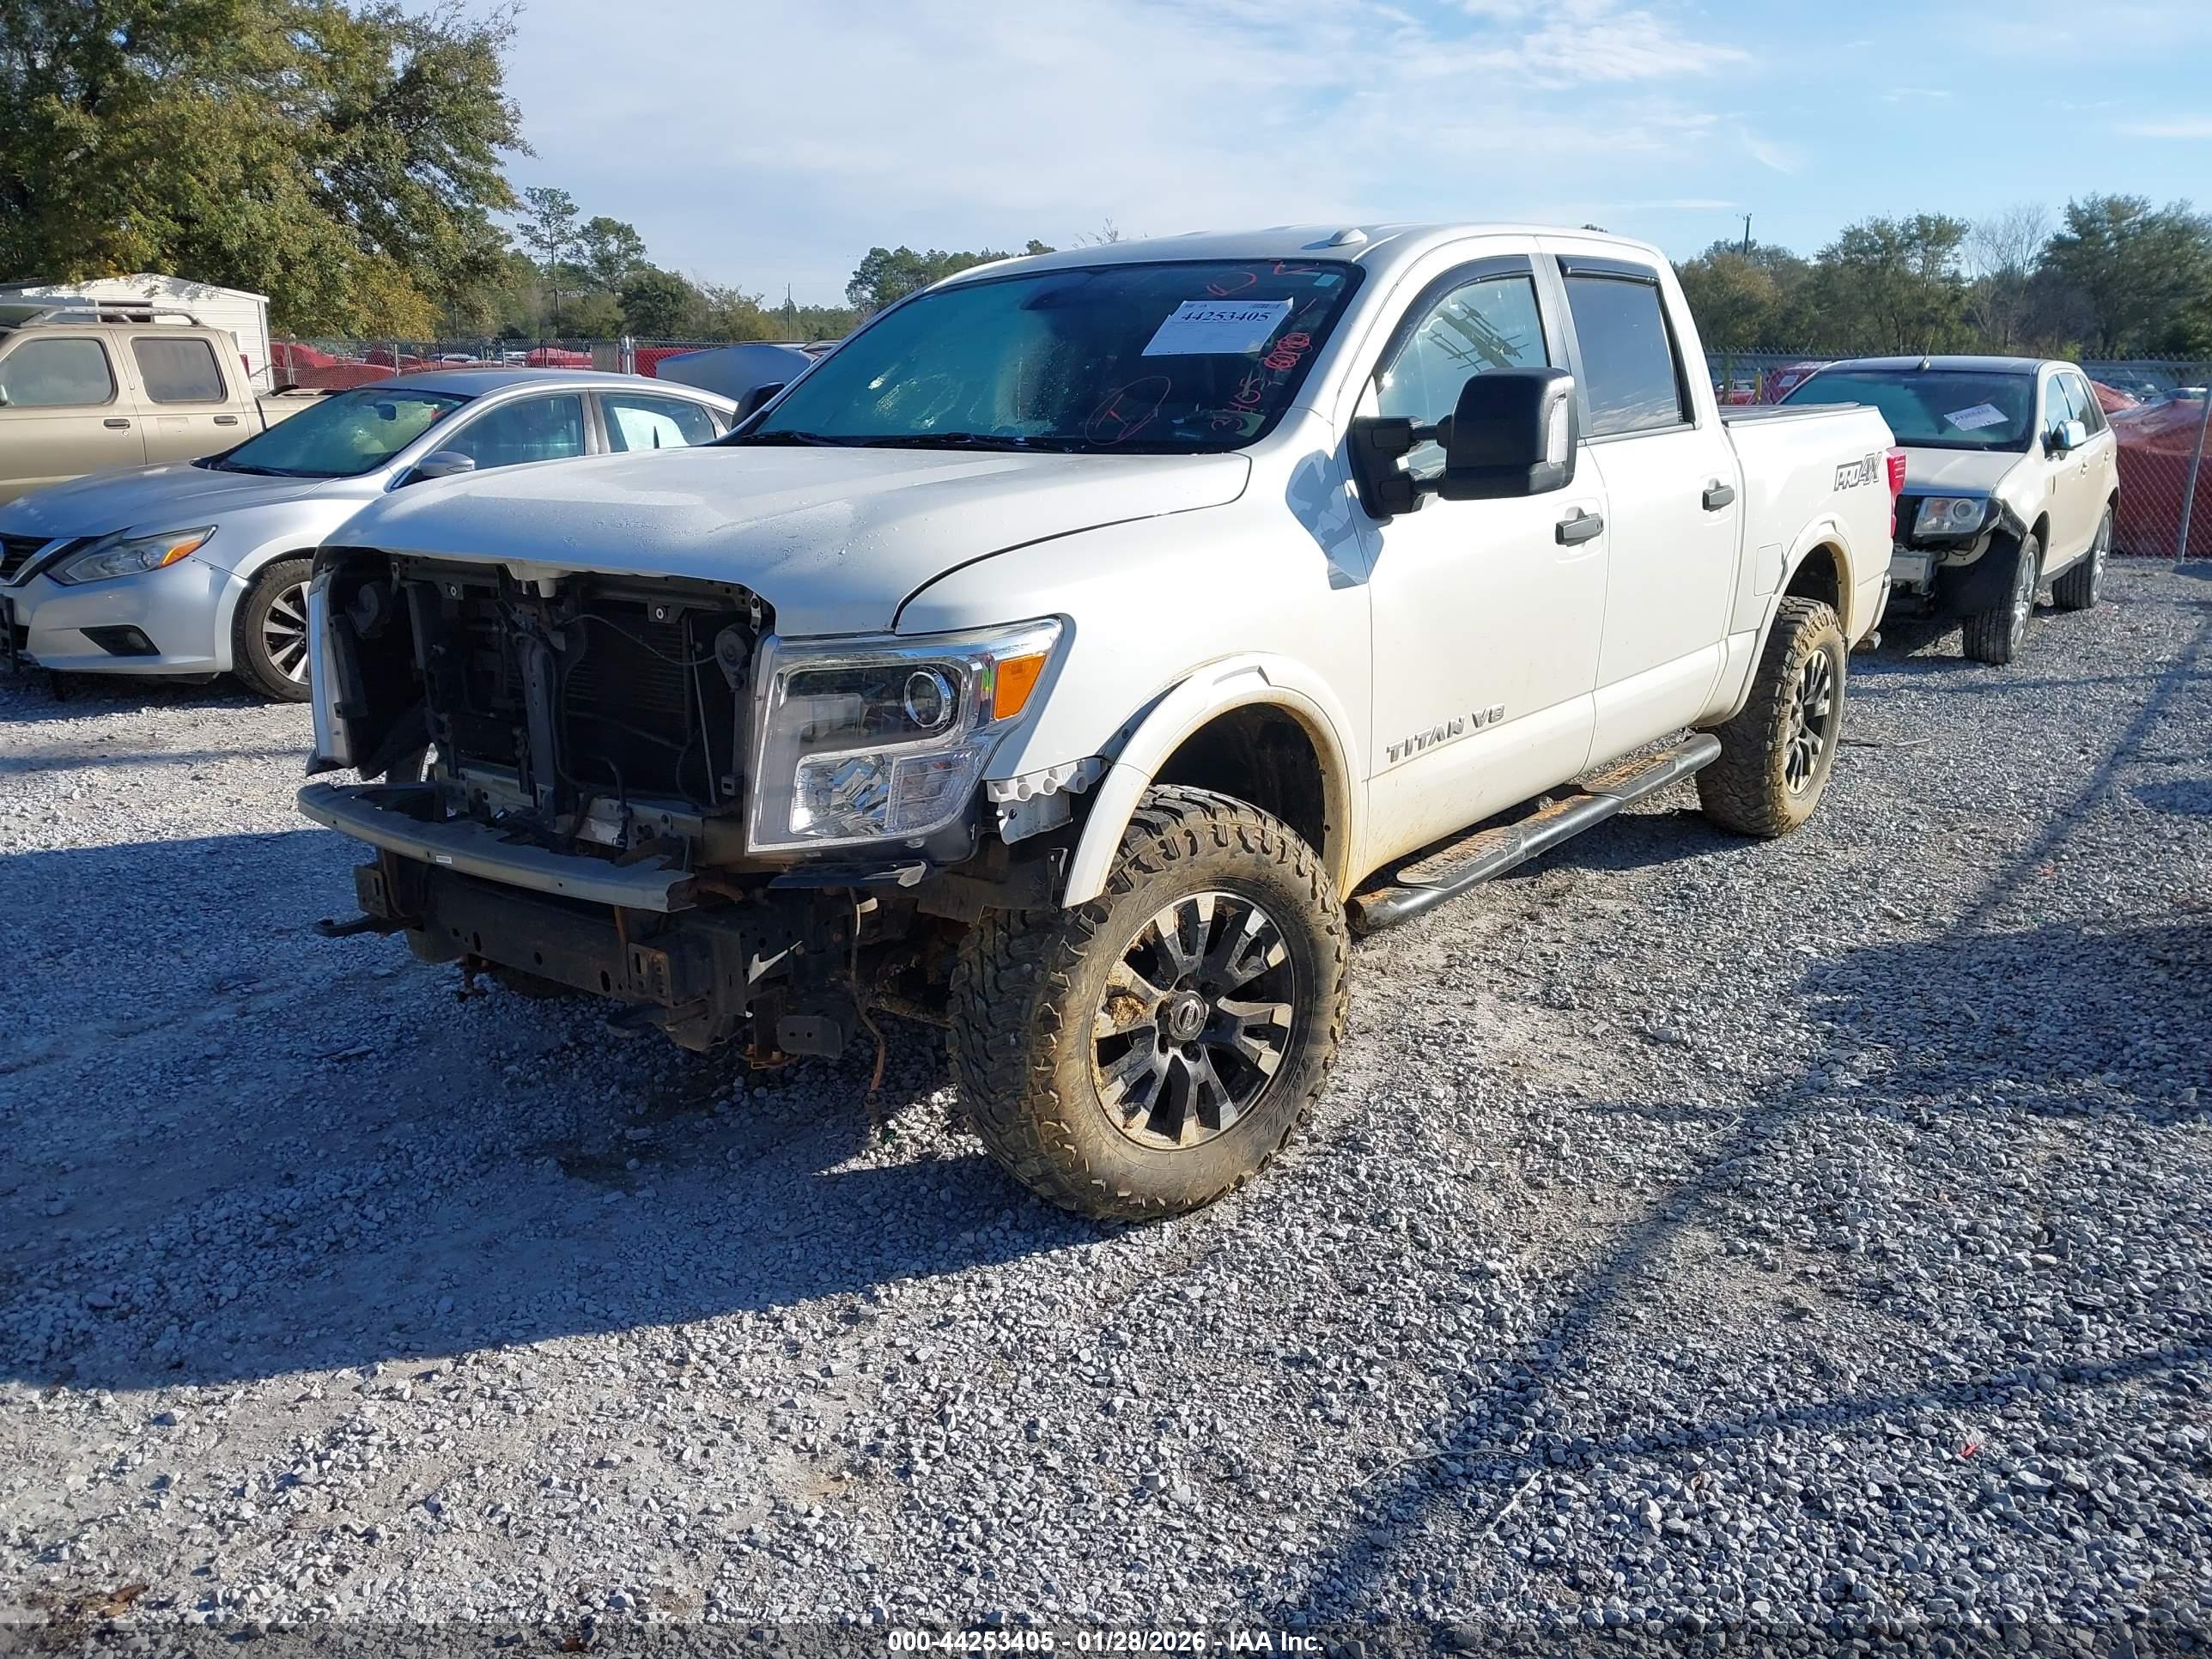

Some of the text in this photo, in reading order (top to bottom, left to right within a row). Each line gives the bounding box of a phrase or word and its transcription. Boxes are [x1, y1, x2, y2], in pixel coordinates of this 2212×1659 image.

[1182, 311, 1272, 322] 44253405
[1386, 702, 1505, 763] TITAN V8
[1182, 1001, 1195, 1031] NISSAN
